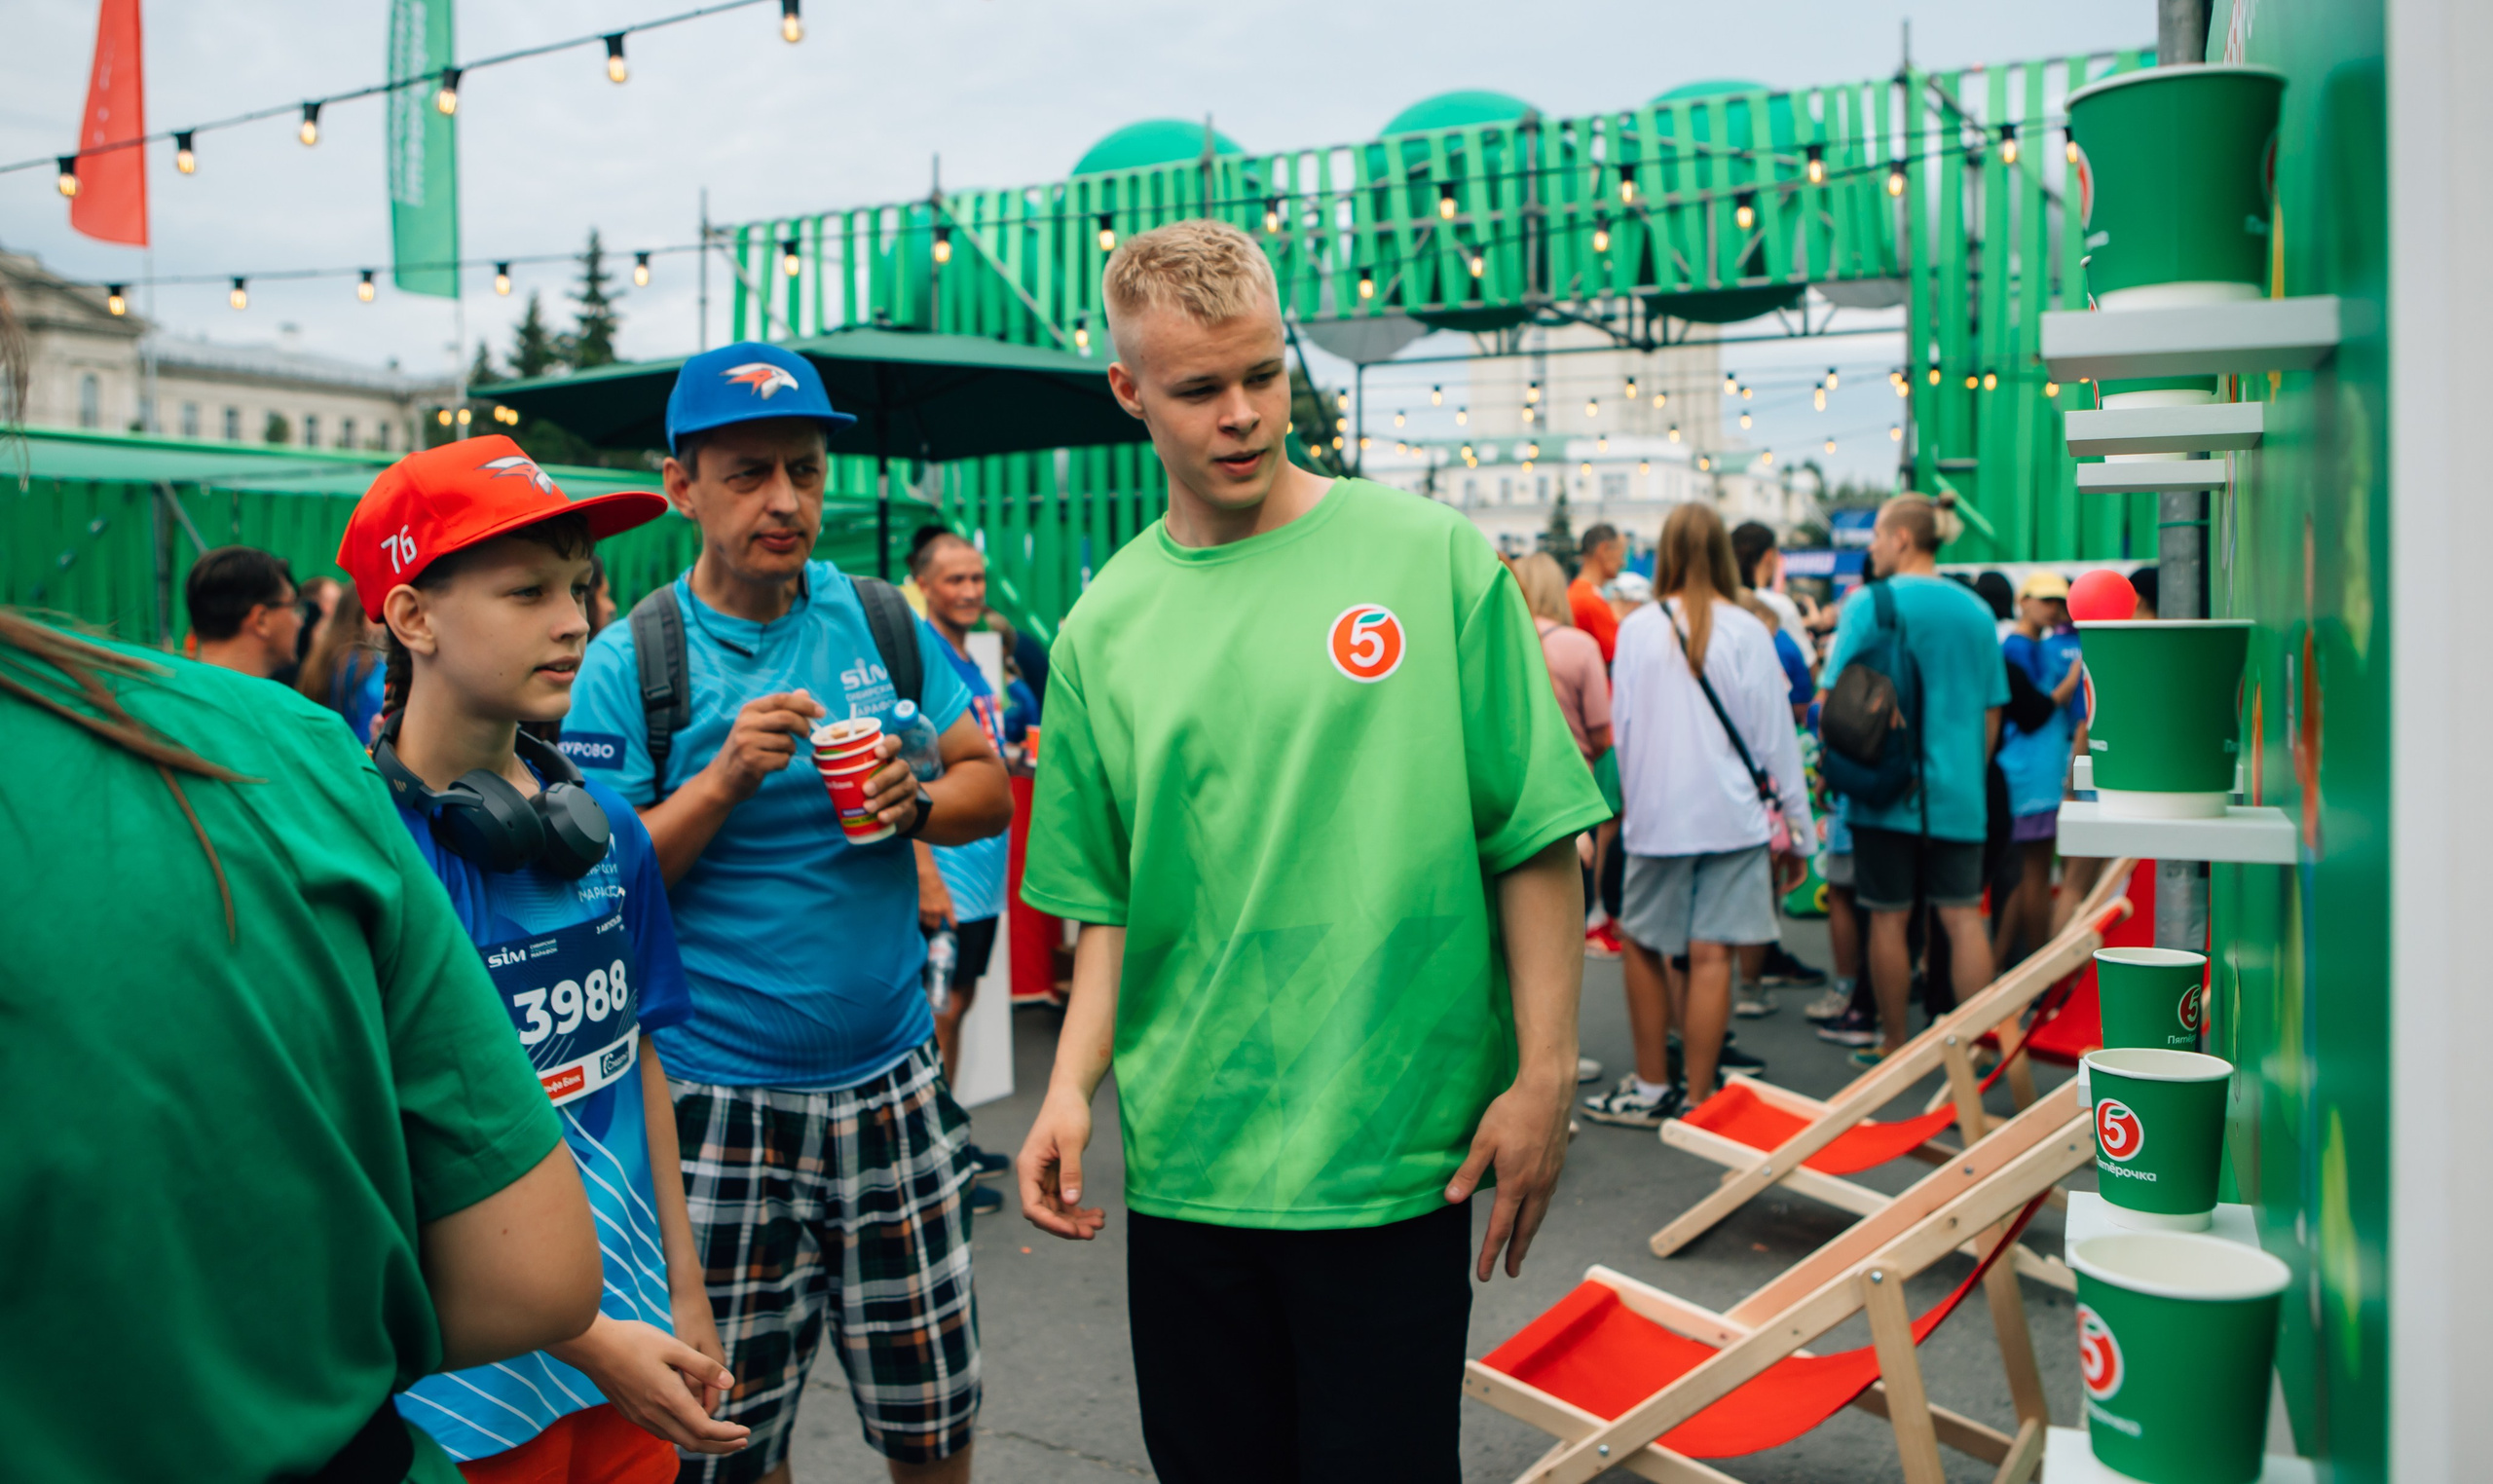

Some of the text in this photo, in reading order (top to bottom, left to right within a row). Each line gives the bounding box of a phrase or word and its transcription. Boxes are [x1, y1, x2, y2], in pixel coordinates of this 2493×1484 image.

[381, 524, 418, 575] 76
[513, 959, 628, 1045] 3988
[2168, 1034, 2196, 1045] Пятёр
